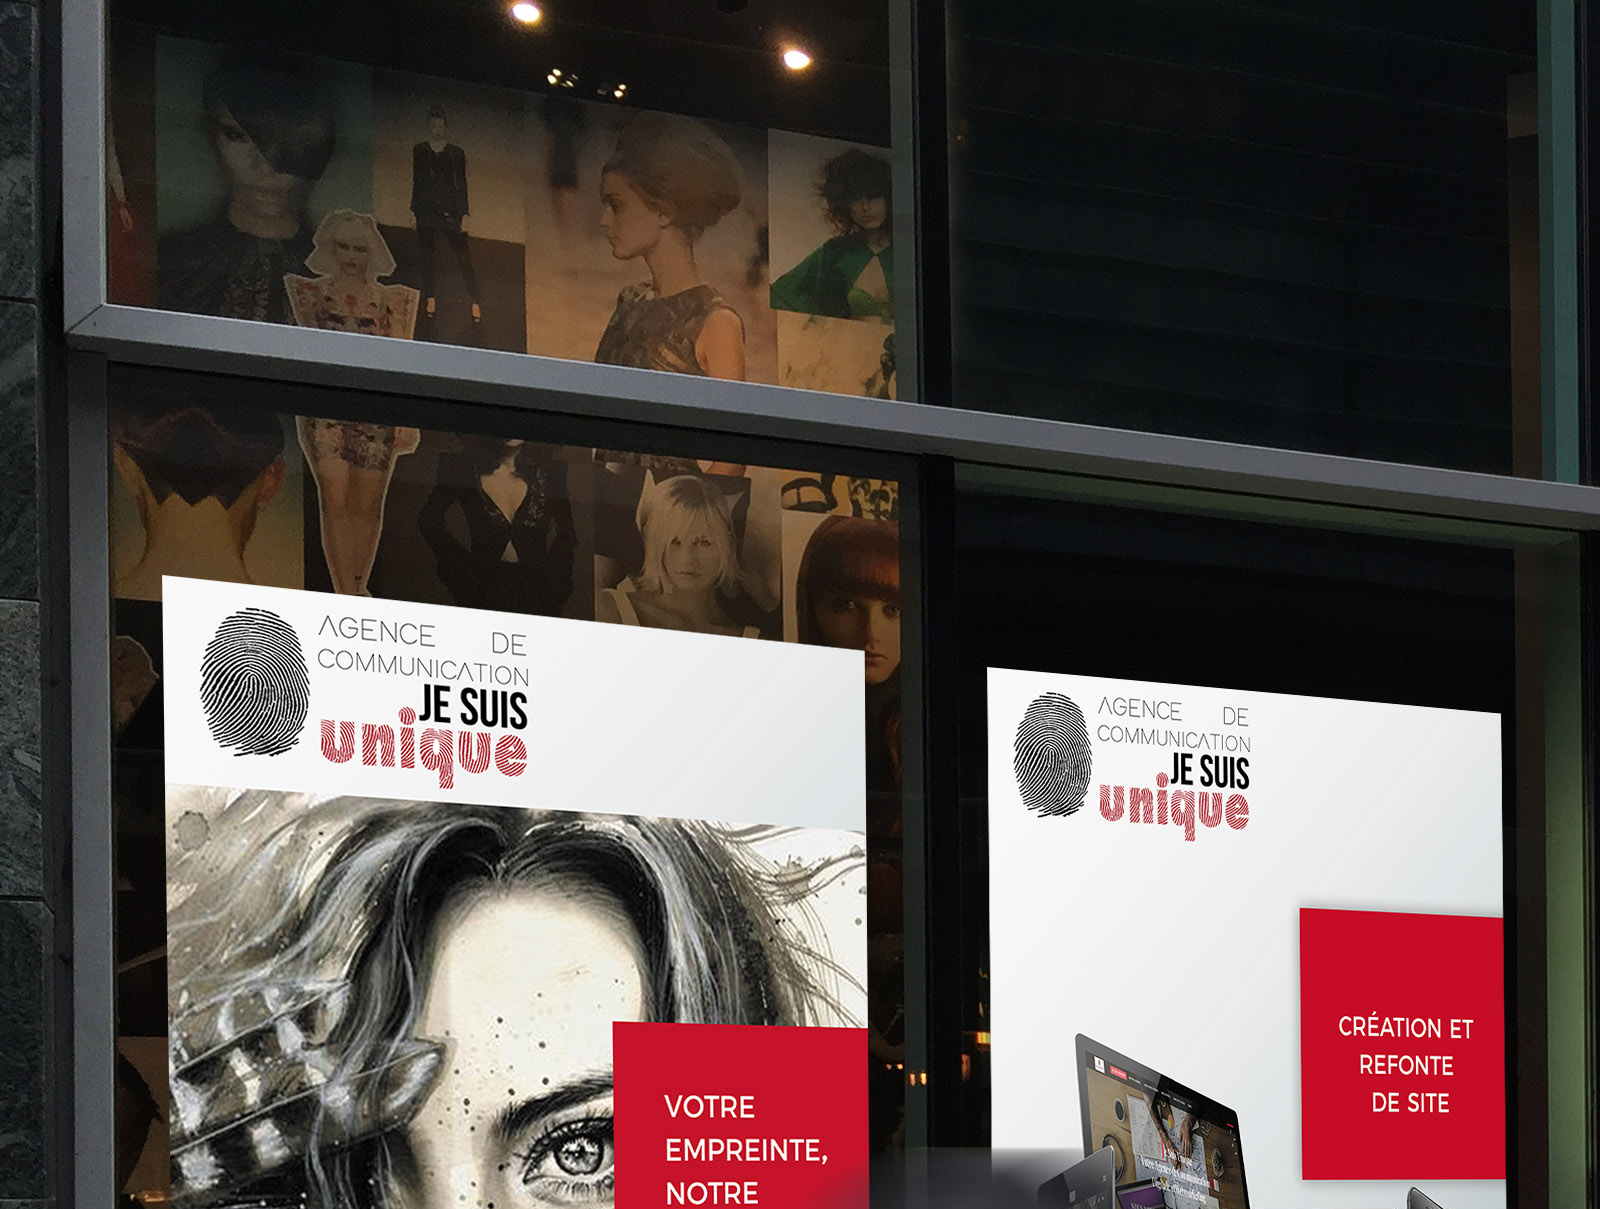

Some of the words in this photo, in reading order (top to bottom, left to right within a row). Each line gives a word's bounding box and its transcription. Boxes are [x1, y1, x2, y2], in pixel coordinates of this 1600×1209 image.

[319, 615, 436, 647] AGENCE
[492, 632, 527, 656] DE
[318, 648, 529, 686] COMMUNICATION
[419, 683, 451, 723] JE
[460, 687, 528, 730] SUIS
[1098, 696, 1182, 721] AGENCE
[1223, 706, 1249, 727] DE
[320, 706, 528, 789] unique
[1097, 724, 1251, 753] COMMUNICATION
[1170, 752, 1194, 786] JE
[1200, 754, 1250, 790] SUIS
[1099, 772, 1250, 842] unique
[1338, 1010, 1441, 1038] CRÉATION
[1450, 1019, 1474, 1039] ET
[1360, 1054, 1454, 1076] REFONTE
[664, 1094, 755, 1118] VOTRE
[1372, 1092, 1400, 1113] DE
[1408, 1092, 1450, 1113] SITE
[666, 1138, 828, 1165] EMPREINTE,
[666, 1181, 759, 1205] NOTRE
